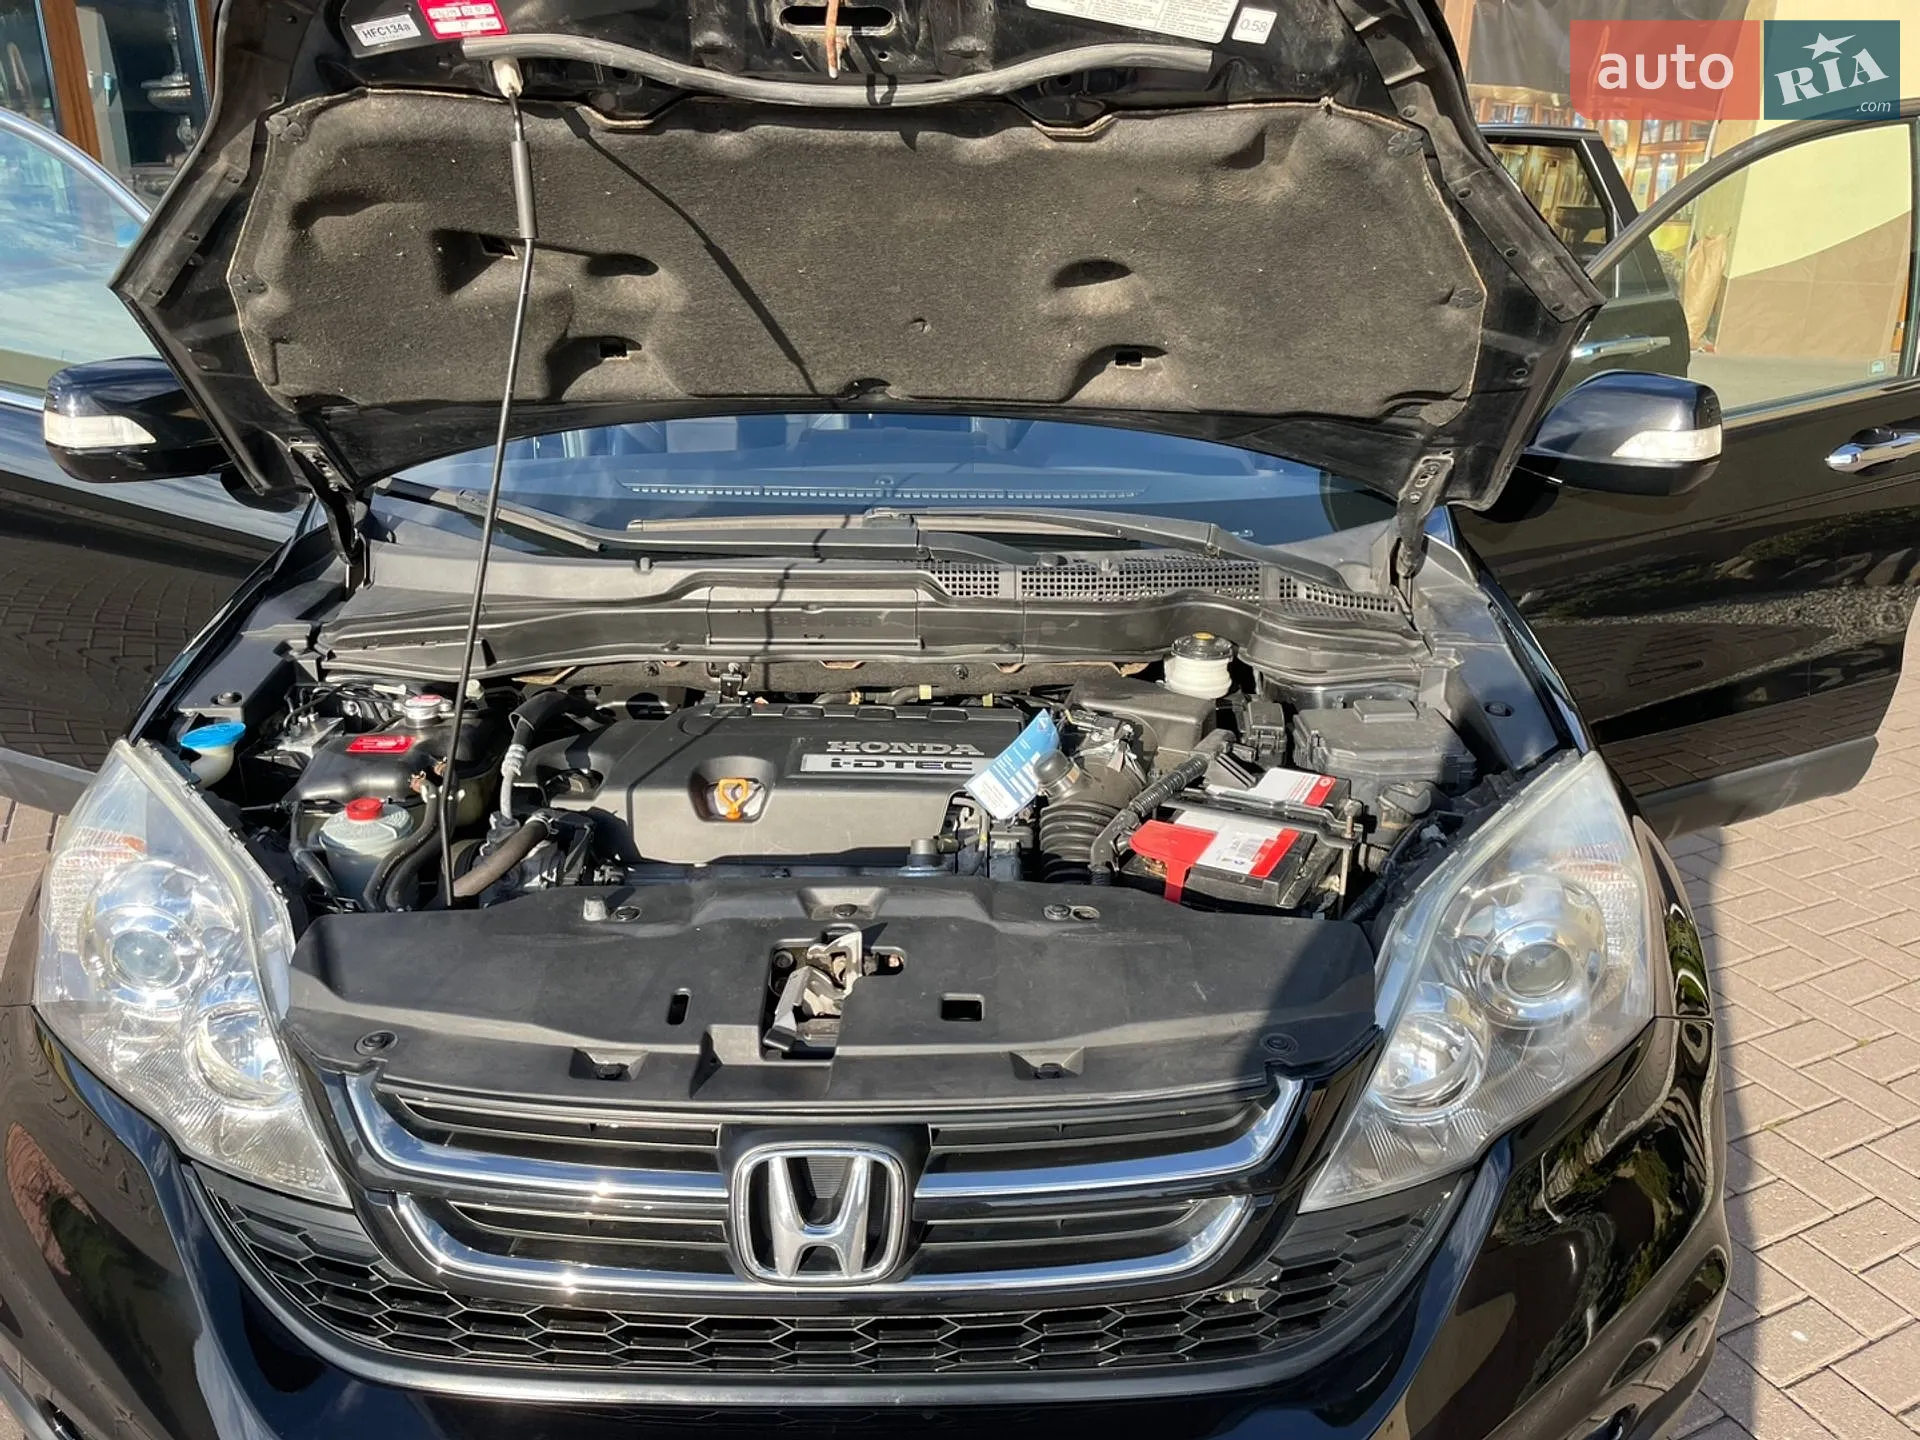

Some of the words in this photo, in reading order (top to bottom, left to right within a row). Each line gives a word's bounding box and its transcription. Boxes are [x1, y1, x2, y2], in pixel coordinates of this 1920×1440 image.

[361, 23, 411, 38] HFC134a
[1240, 19, 1268, 33] 0.58
[826, 741, 985, 756] HONDA
[830, 757, 973, 771] i-DTEC
